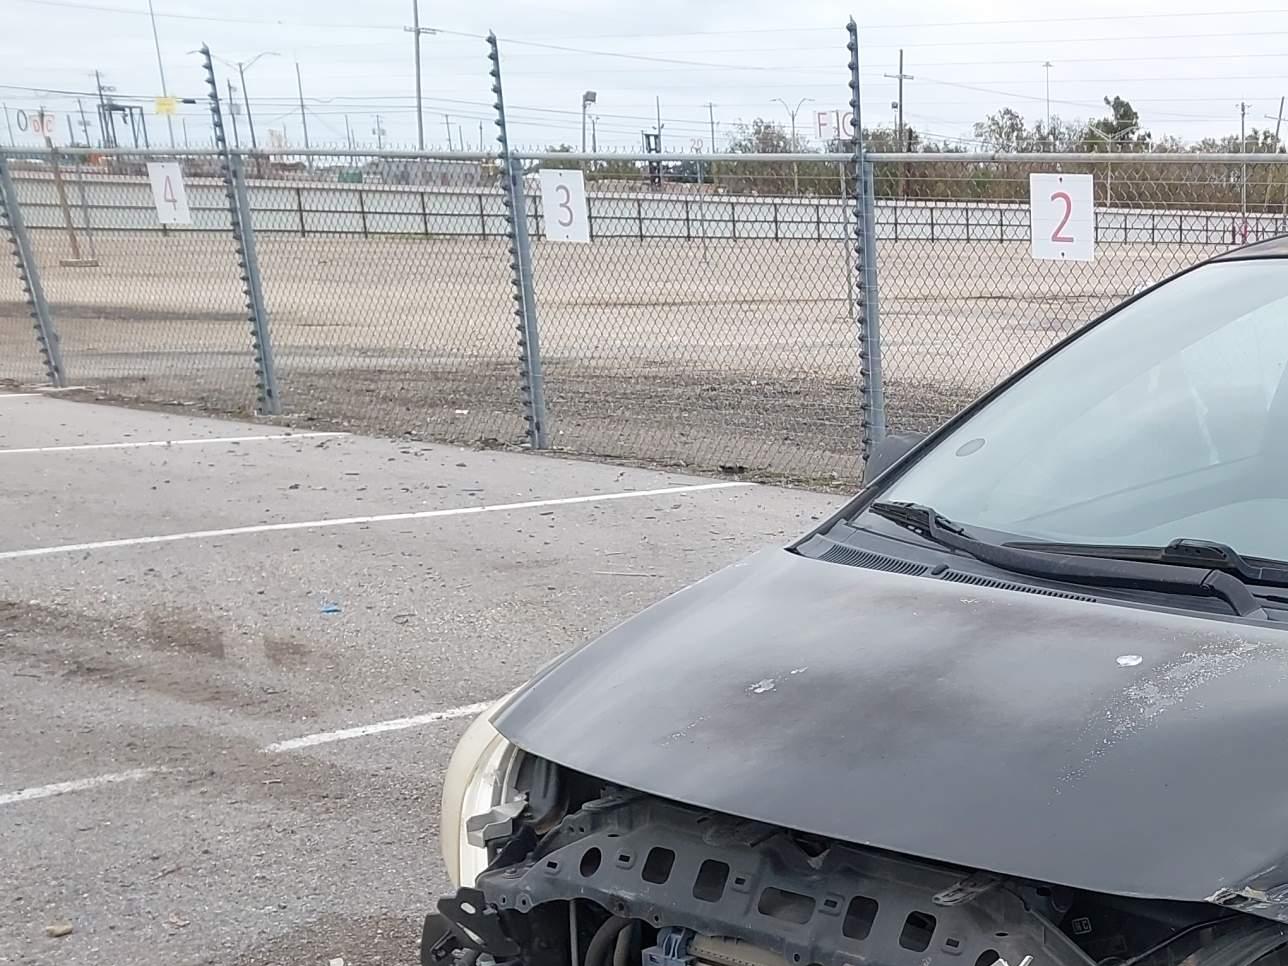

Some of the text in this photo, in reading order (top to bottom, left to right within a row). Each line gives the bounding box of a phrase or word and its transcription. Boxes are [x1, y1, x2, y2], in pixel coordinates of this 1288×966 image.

[164, 175, 178, 210] 4
[555, 184, 573, 228] 3
[1050, 191, 1075, 243] 2
